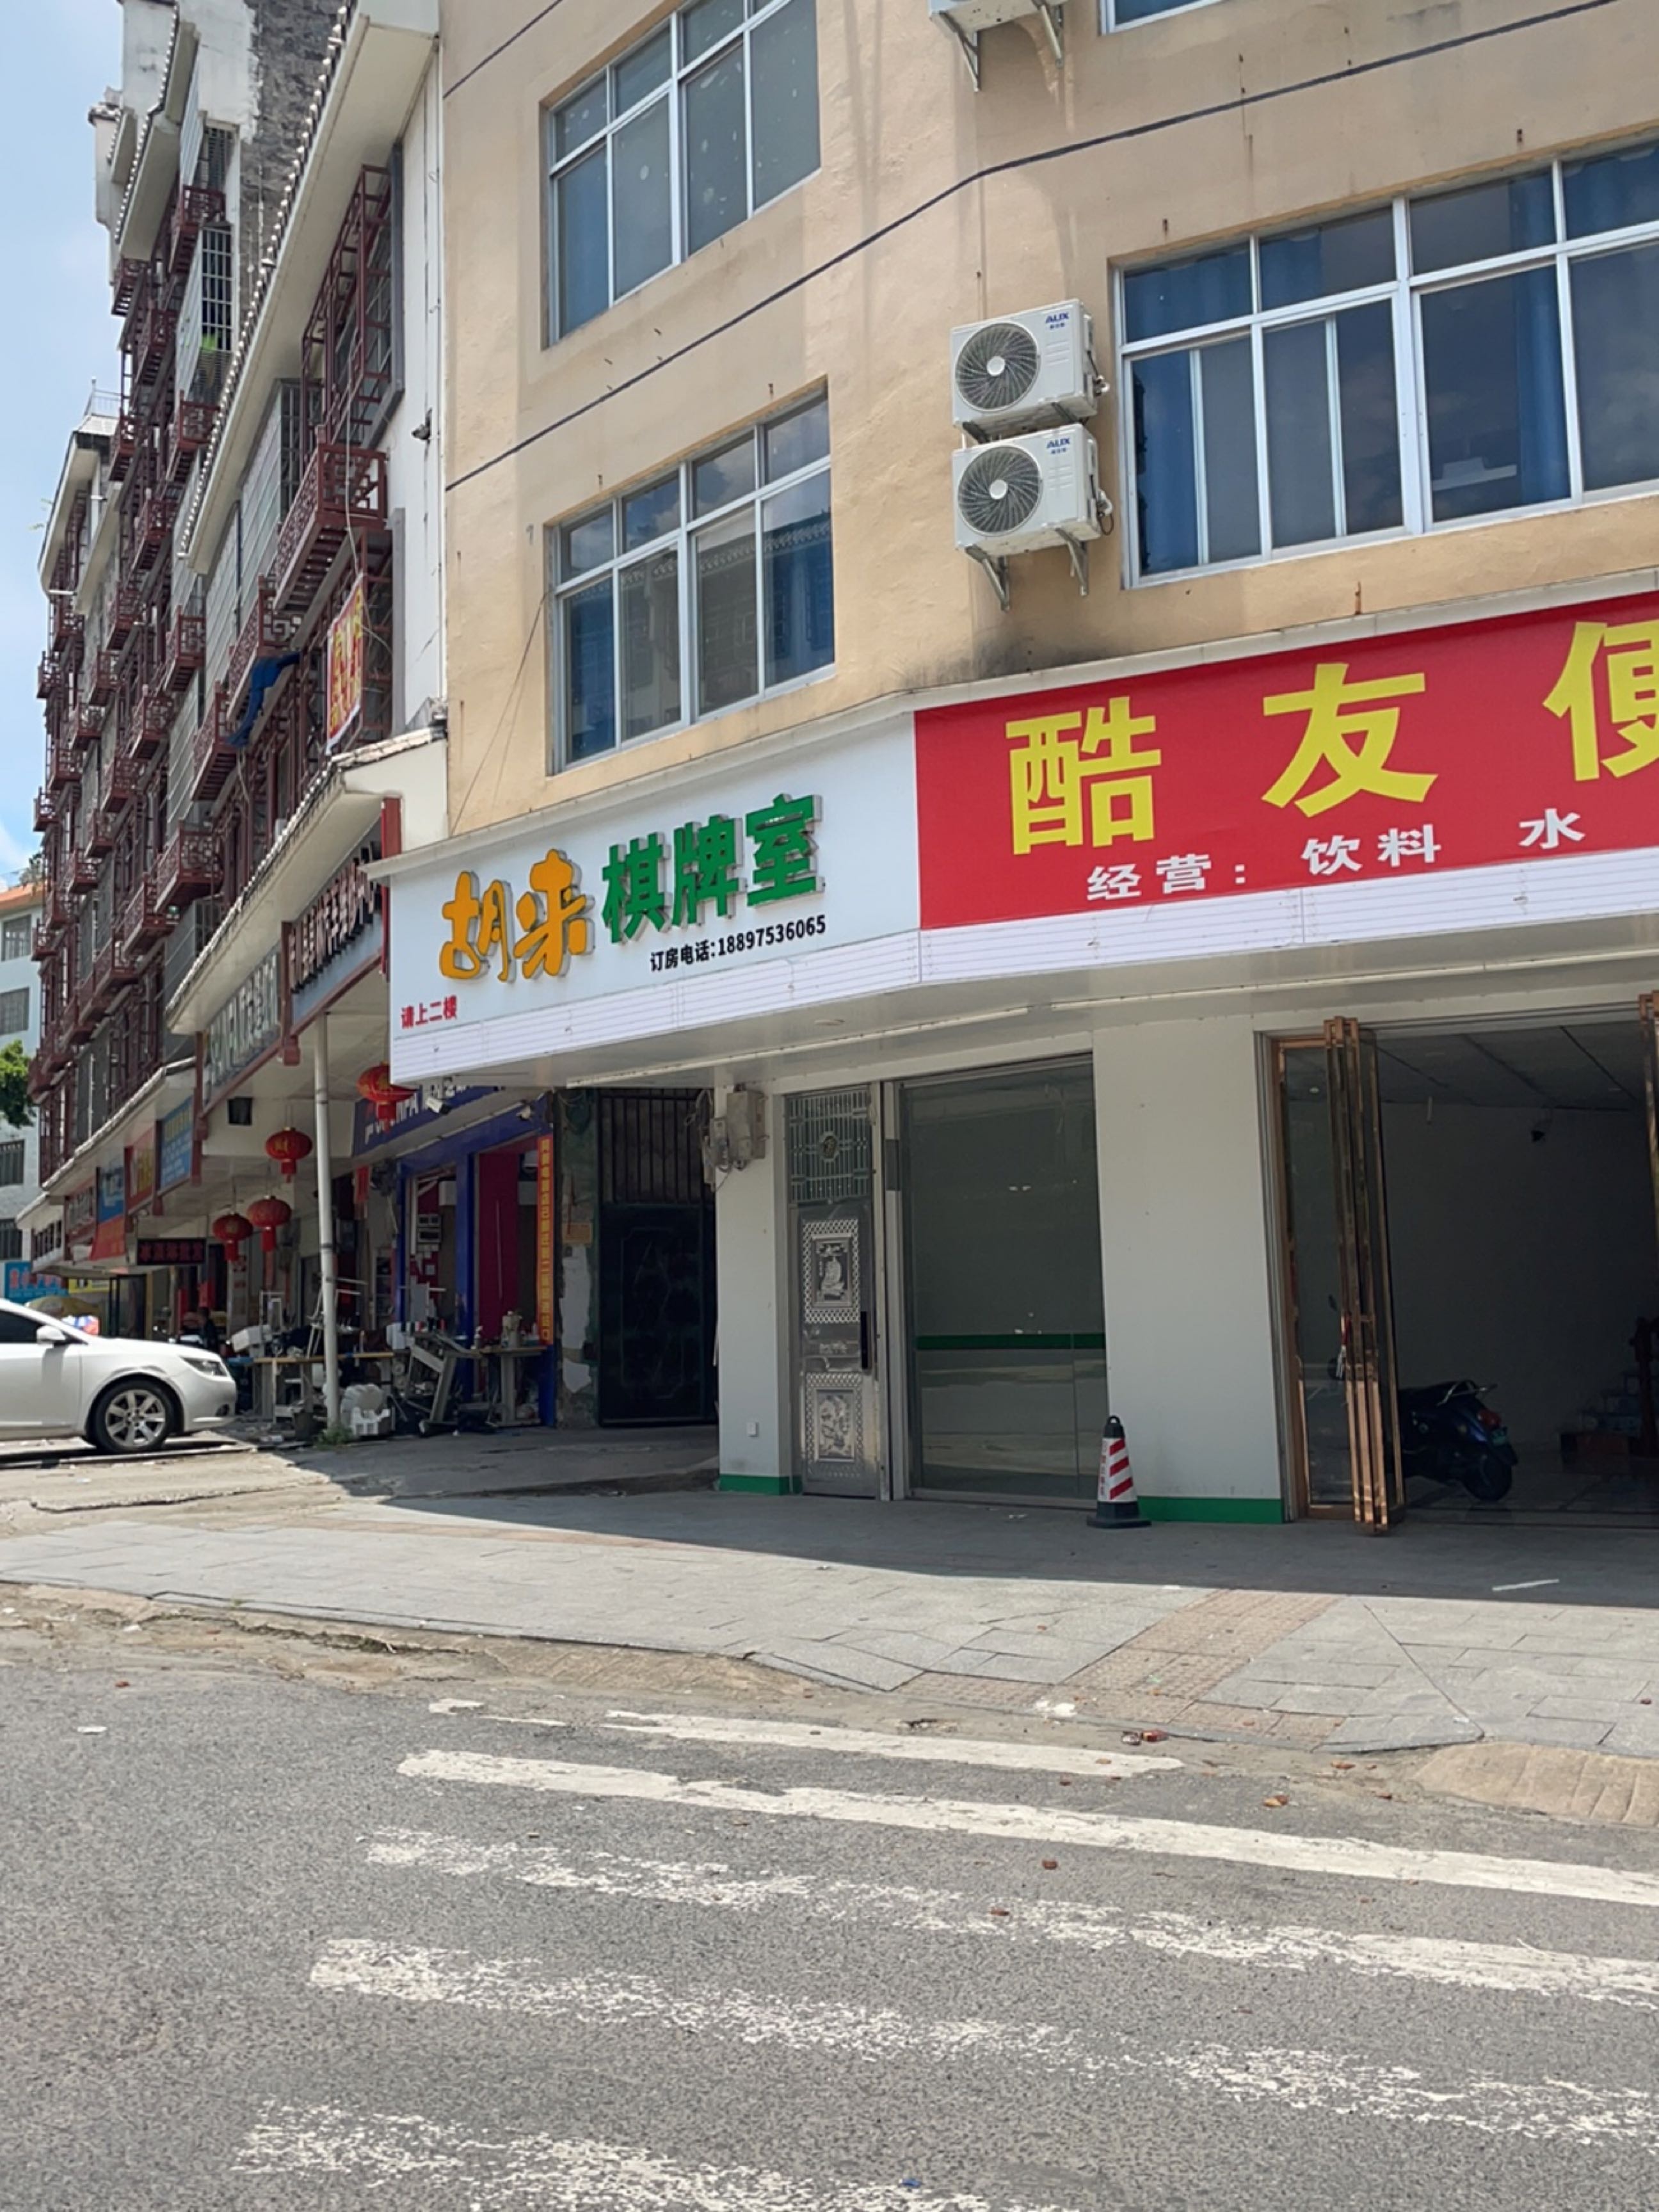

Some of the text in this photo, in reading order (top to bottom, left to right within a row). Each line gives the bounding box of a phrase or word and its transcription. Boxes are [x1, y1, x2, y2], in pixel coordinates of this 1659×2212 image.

[1519, 808, 1585, 849] 水
[401, 994, 458, 1029] 请上二楼
